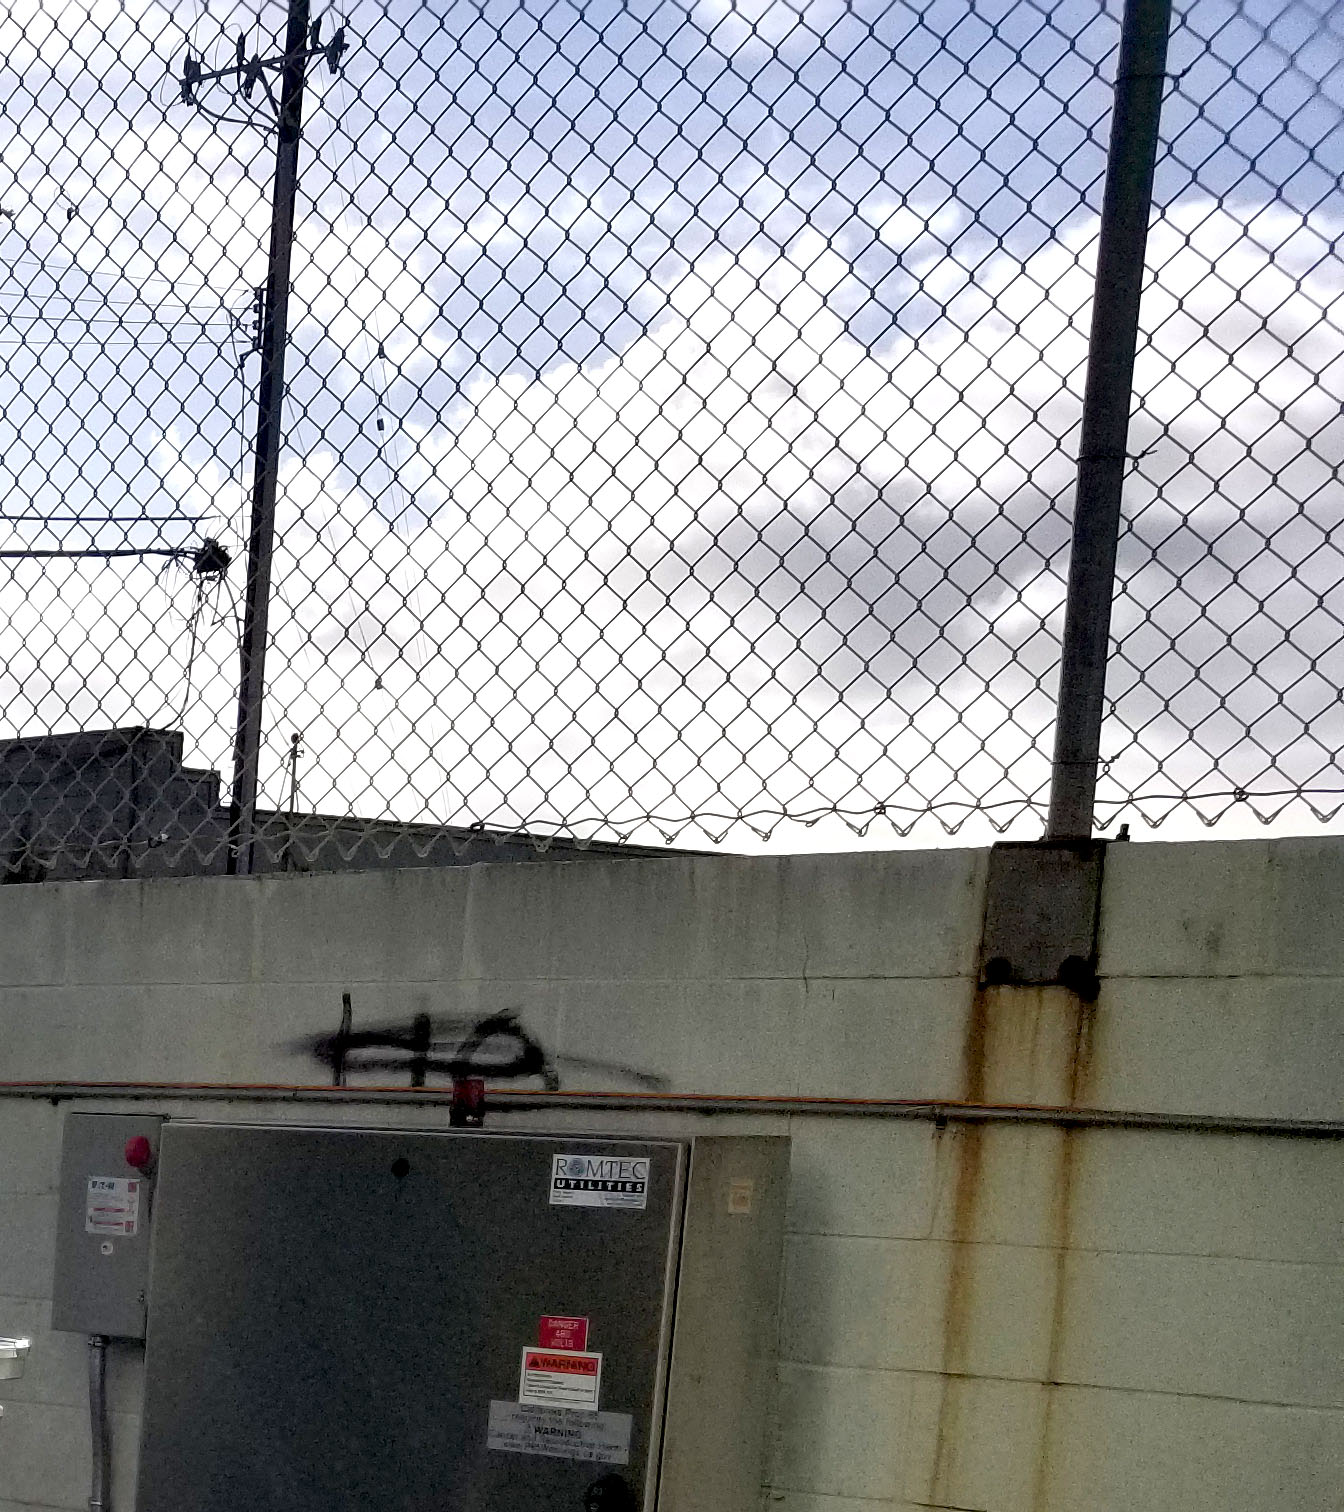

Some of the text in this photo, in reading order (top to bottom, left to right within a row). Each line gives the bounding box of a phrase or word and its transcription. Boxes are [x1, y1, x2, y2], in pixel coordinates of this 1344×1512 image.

[556, 1179, 643, 1192] UTILITIES
[540, 1357, 595, 1372] WARNING
[534, 1426, 582, 1439] WARNING
